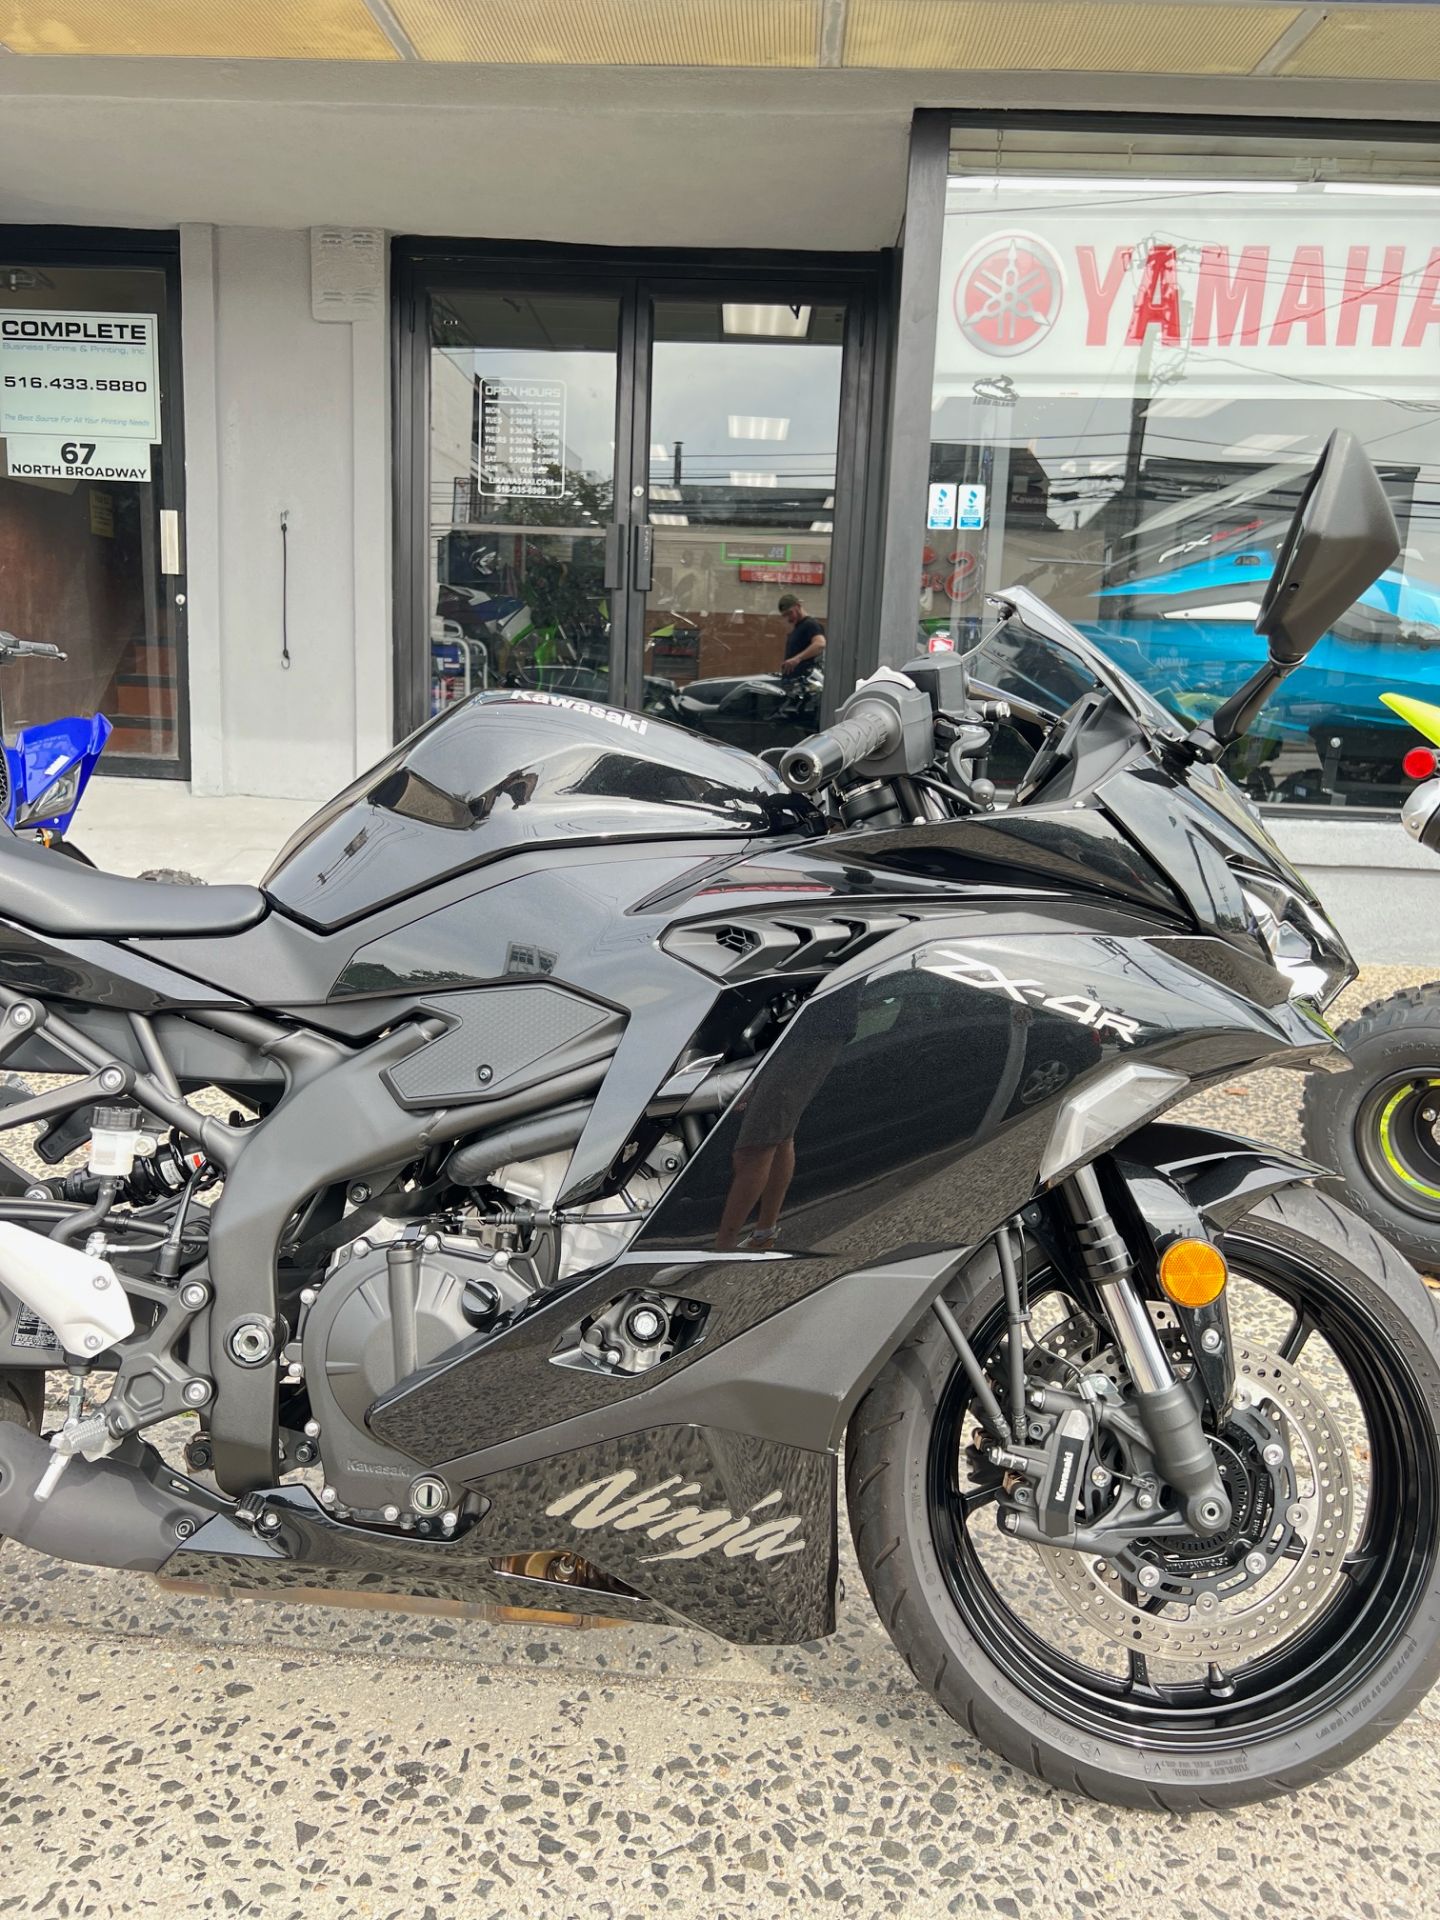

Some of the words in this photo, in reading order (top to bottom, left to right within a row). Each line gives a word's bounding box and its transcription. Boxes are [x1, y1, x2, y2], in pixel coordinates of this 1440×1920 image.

[1075, 245, 1440, 347] YAMAHA
[2, 320, 147, 340] COMPLETE
[2, 342, 44, 351] Business
[46, 343, 77, 352] Forms
[79, 345, 87, 353] &
[4, 375, 147, 393] 516.433.5880
[485, 386, 517, 396] OPEN
[519, 387, 560, 398] HOURS
[18, 414, 34, 422] Best
[35, 415, 59, 423] Source
[101, 417, 128, 426] Printing
[60, 442, 97, 465] 67
[12, 464, 62, 475] NORTH
[65, 466, 147, 479] BROADWAY
[510, 690, 649, 735] Kawasaki
[919, 950, 1140, 1044] ZX-4R
[346, 1458, 411, 1478] Kawasaki
[1055, 1451, 1073, 1502] Kawasaki
[545, 1467, 807, 1565] Ninja
